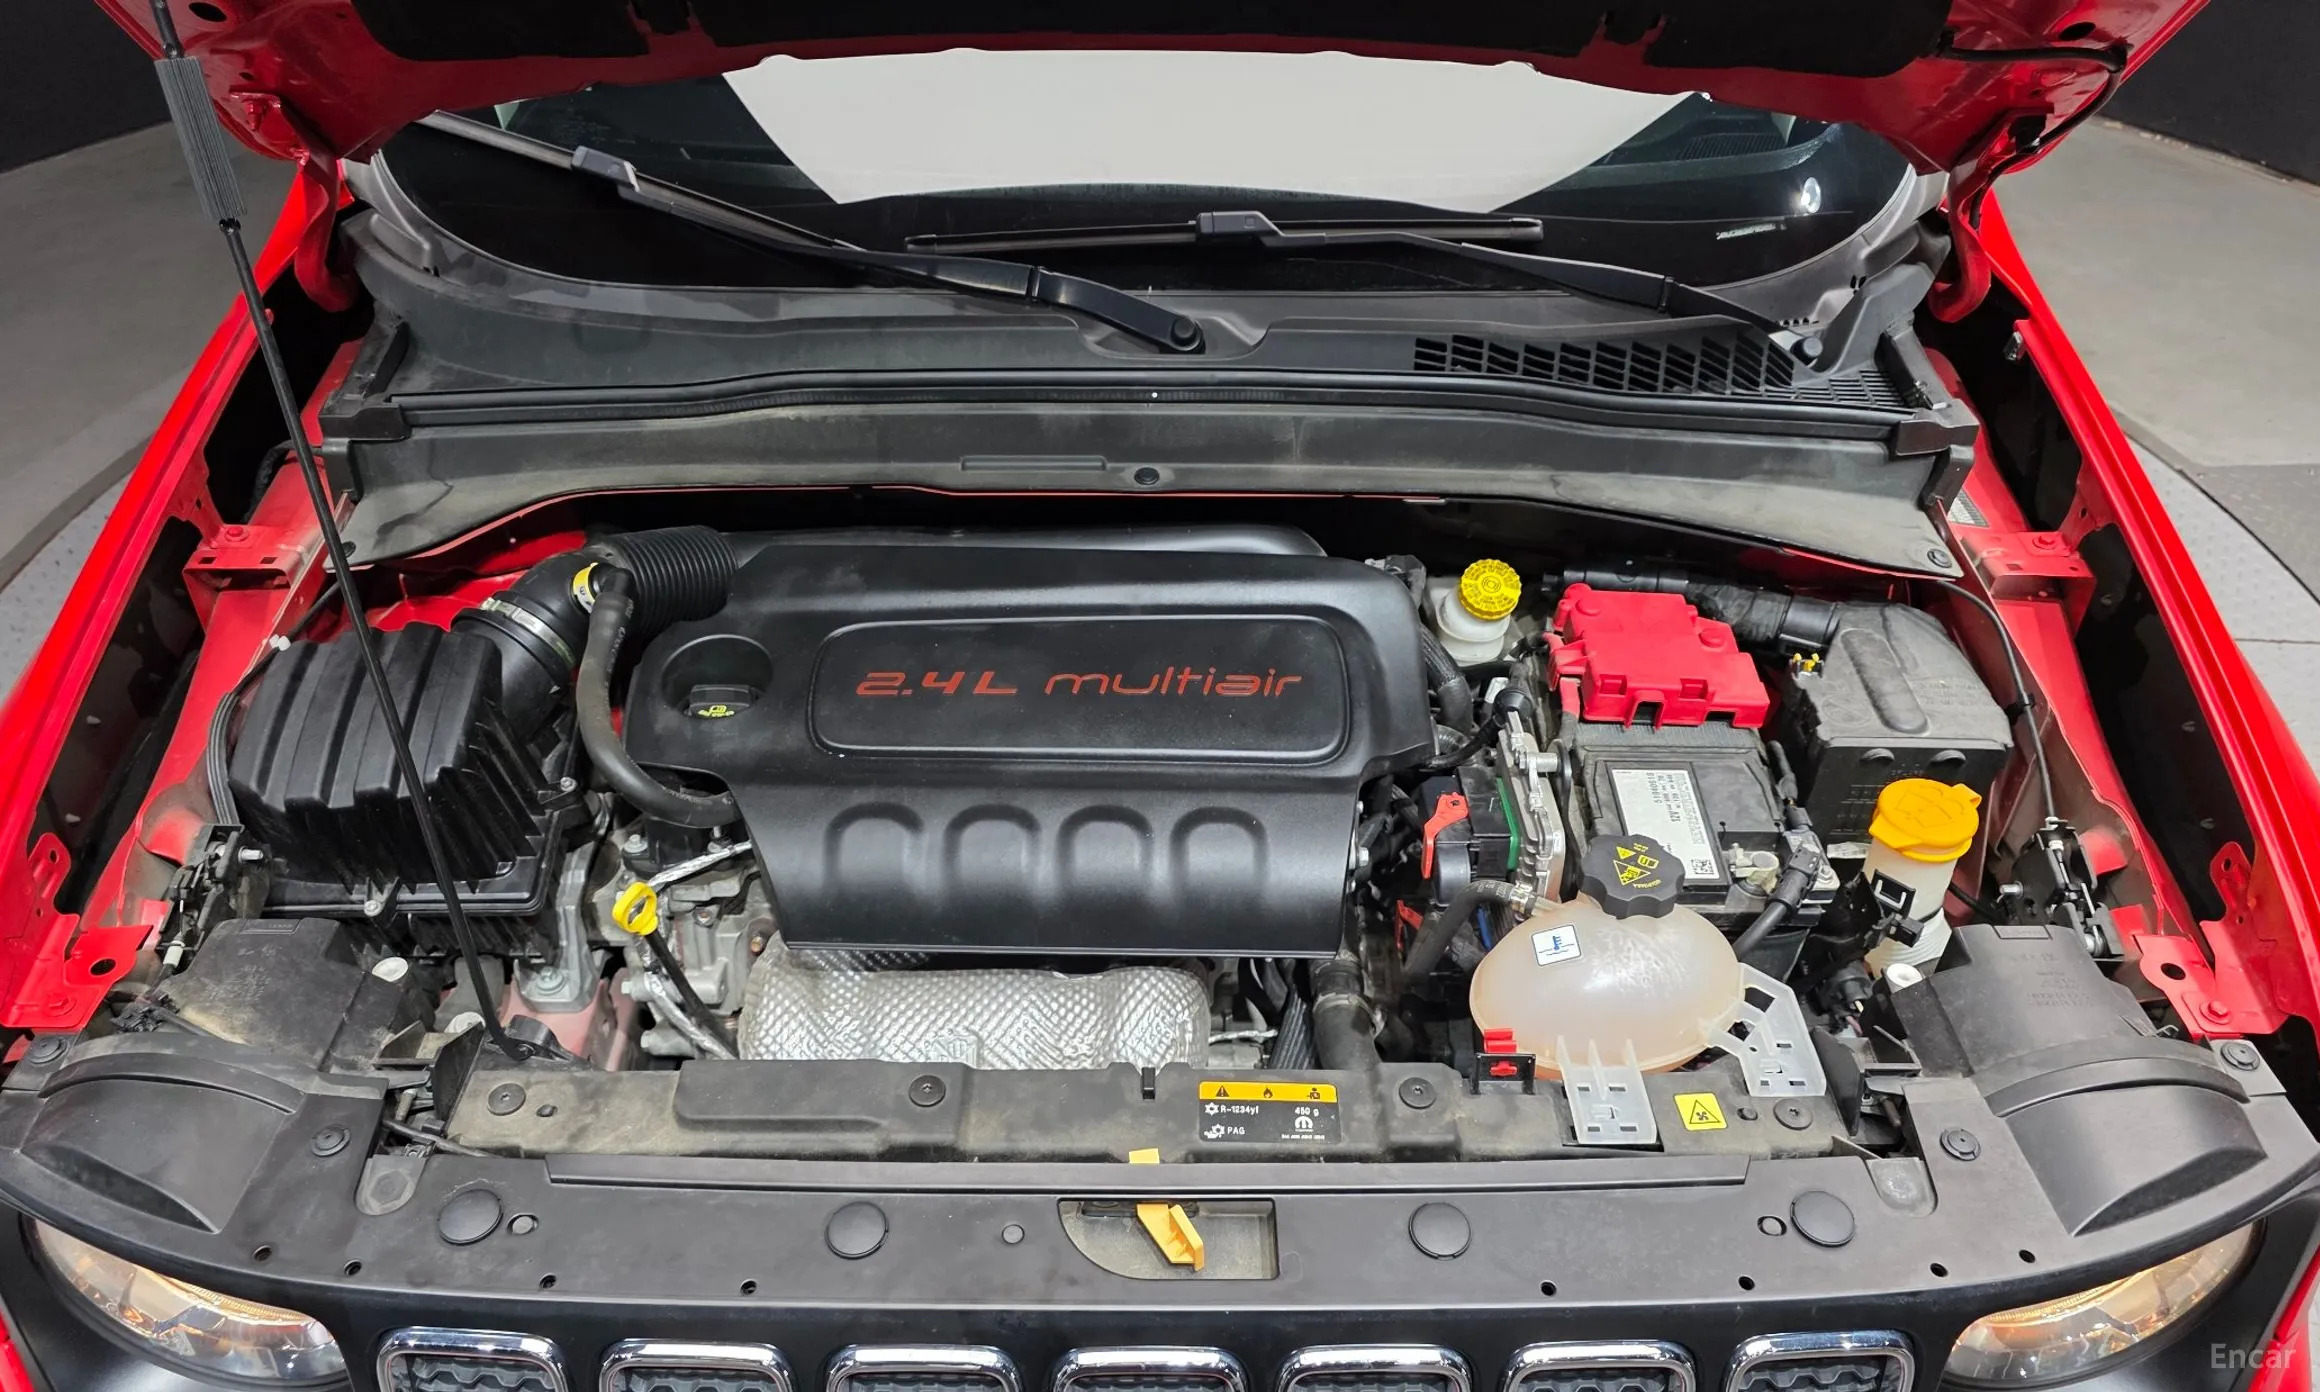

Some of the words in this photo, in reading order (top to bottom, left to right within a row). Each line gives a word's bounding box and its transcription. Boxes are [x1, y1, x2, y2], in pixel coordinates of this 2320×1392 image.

[1044, 666, 1303, 697] multiair
[1294, 1106, 1311, 1116] 450
[1227, 1126, 1246, 1135] PAG
